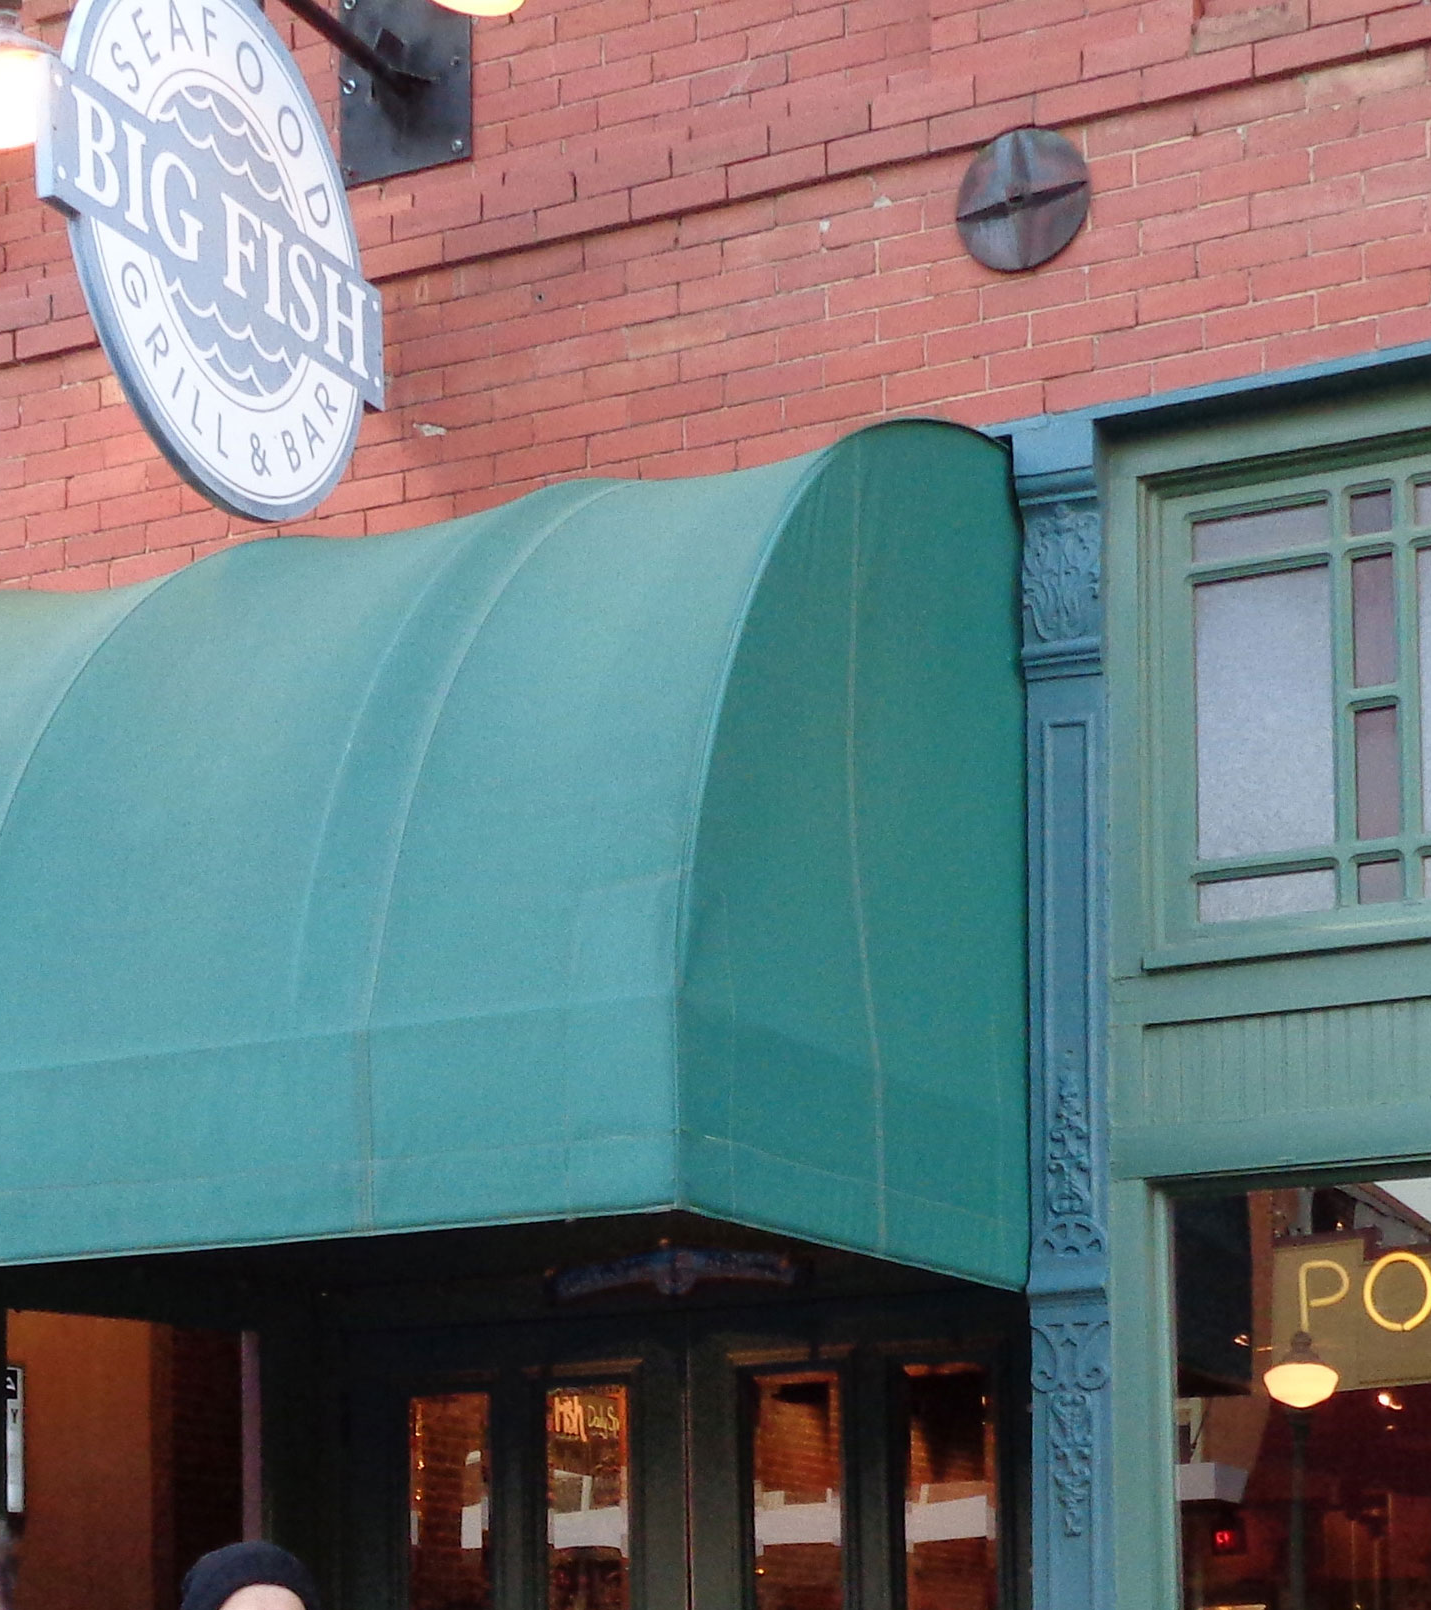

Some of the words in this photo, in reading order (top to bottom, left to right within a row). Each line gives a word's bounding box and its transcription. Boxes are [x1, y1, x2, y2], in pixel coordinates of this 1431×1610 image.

[109, 5, 331, 230] SEAFOOD
[71, 84, 204, 262] BIG
[220, 192, 369, 380] FISH
[120, 261, 229, 459] GRILL
[250, 432, 272, 478] &
[277, 381, 339, 474] BAR
